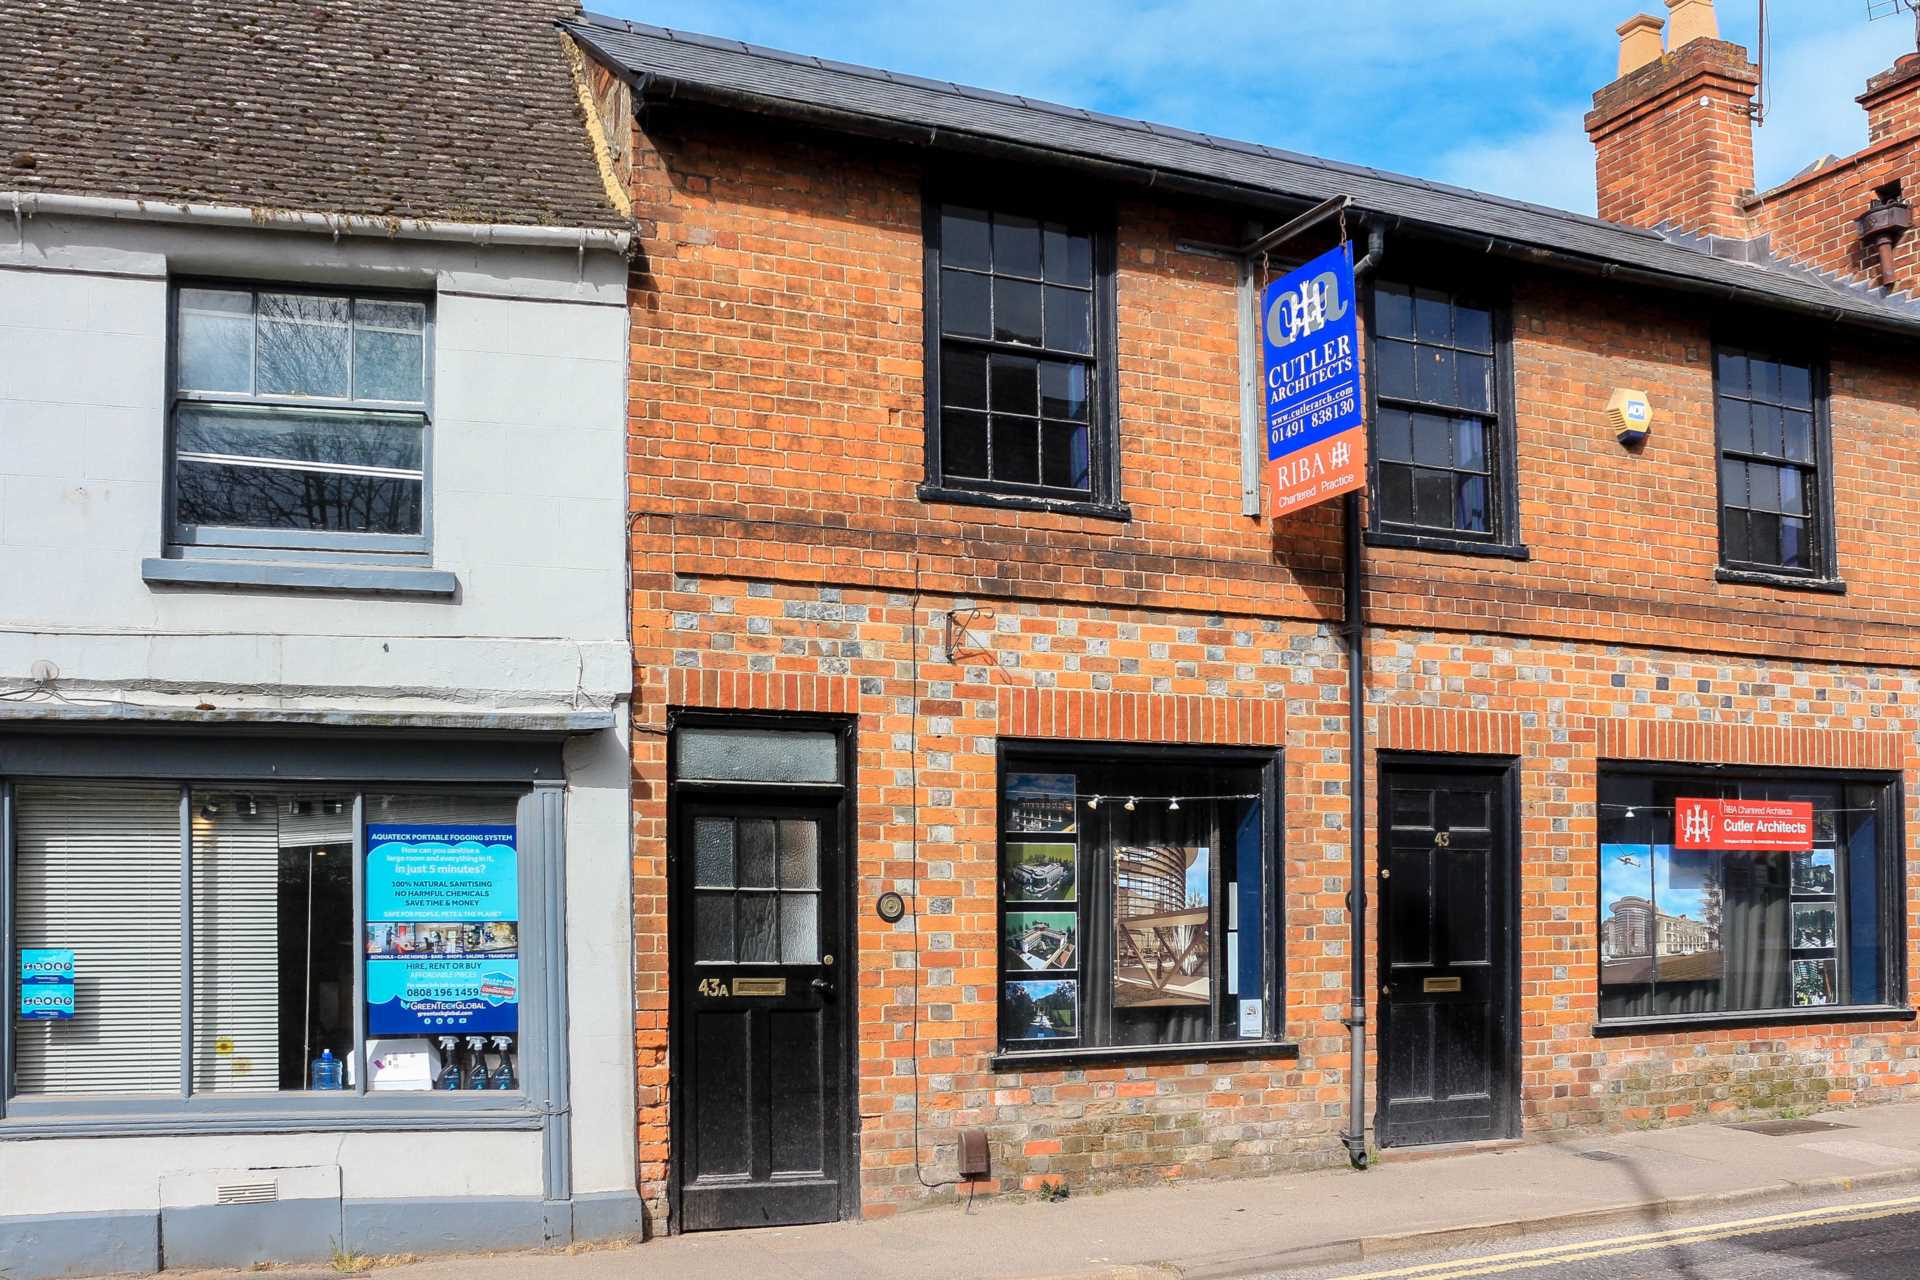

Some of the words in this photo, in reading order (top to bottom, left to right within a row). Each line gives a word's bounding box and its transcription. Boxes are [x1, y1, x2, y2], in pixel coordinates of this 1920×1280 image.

[1269, 335, 1351, 388] CUTLER
[1271, 356, 1352, 405] ARCHITECTS
[1271, 386, 1353, 427] www.cutlerarch.com
[1271, 418, 1304, 445] 01491
[1311, 398, 1354, 428] 838130
[1278, 452, 1325, 491] RIBA
[1279, 485, 1316, 509] Chartered
[1321, 472, 1355, 493] Practice
[1765, 806, 1793, 817] Architects
[1723, 817, 1754, 832] Cutler
[1756, 819, 1807, 834] Architects
[371, 833, 411, 841] AQUATECK
[412, 833, 449, 841] PORTABLE
[1434, 831, 1450, 847] 43
[406, 863, 425, 876] just
[429, 864, 436, 873] 5
[438, 864, 486, 873] minutes?
[392, 880, 412, 888] 100%
[413, 880, 449, 888] NATURAL
[450, 880, 492, 888] SANITISING
[406, 962, 427, 970] HIRE,
[429, 962, 450, 970] RENT
[452, 962, 465, 970] OR
[465, 962, 481, 970] BUY
[406, 988, 432, 997] 0808
[434, 988, 453, 997] 196
[455, 988, 479, 997] 1459
[698, 978, 729, 997] 43A
